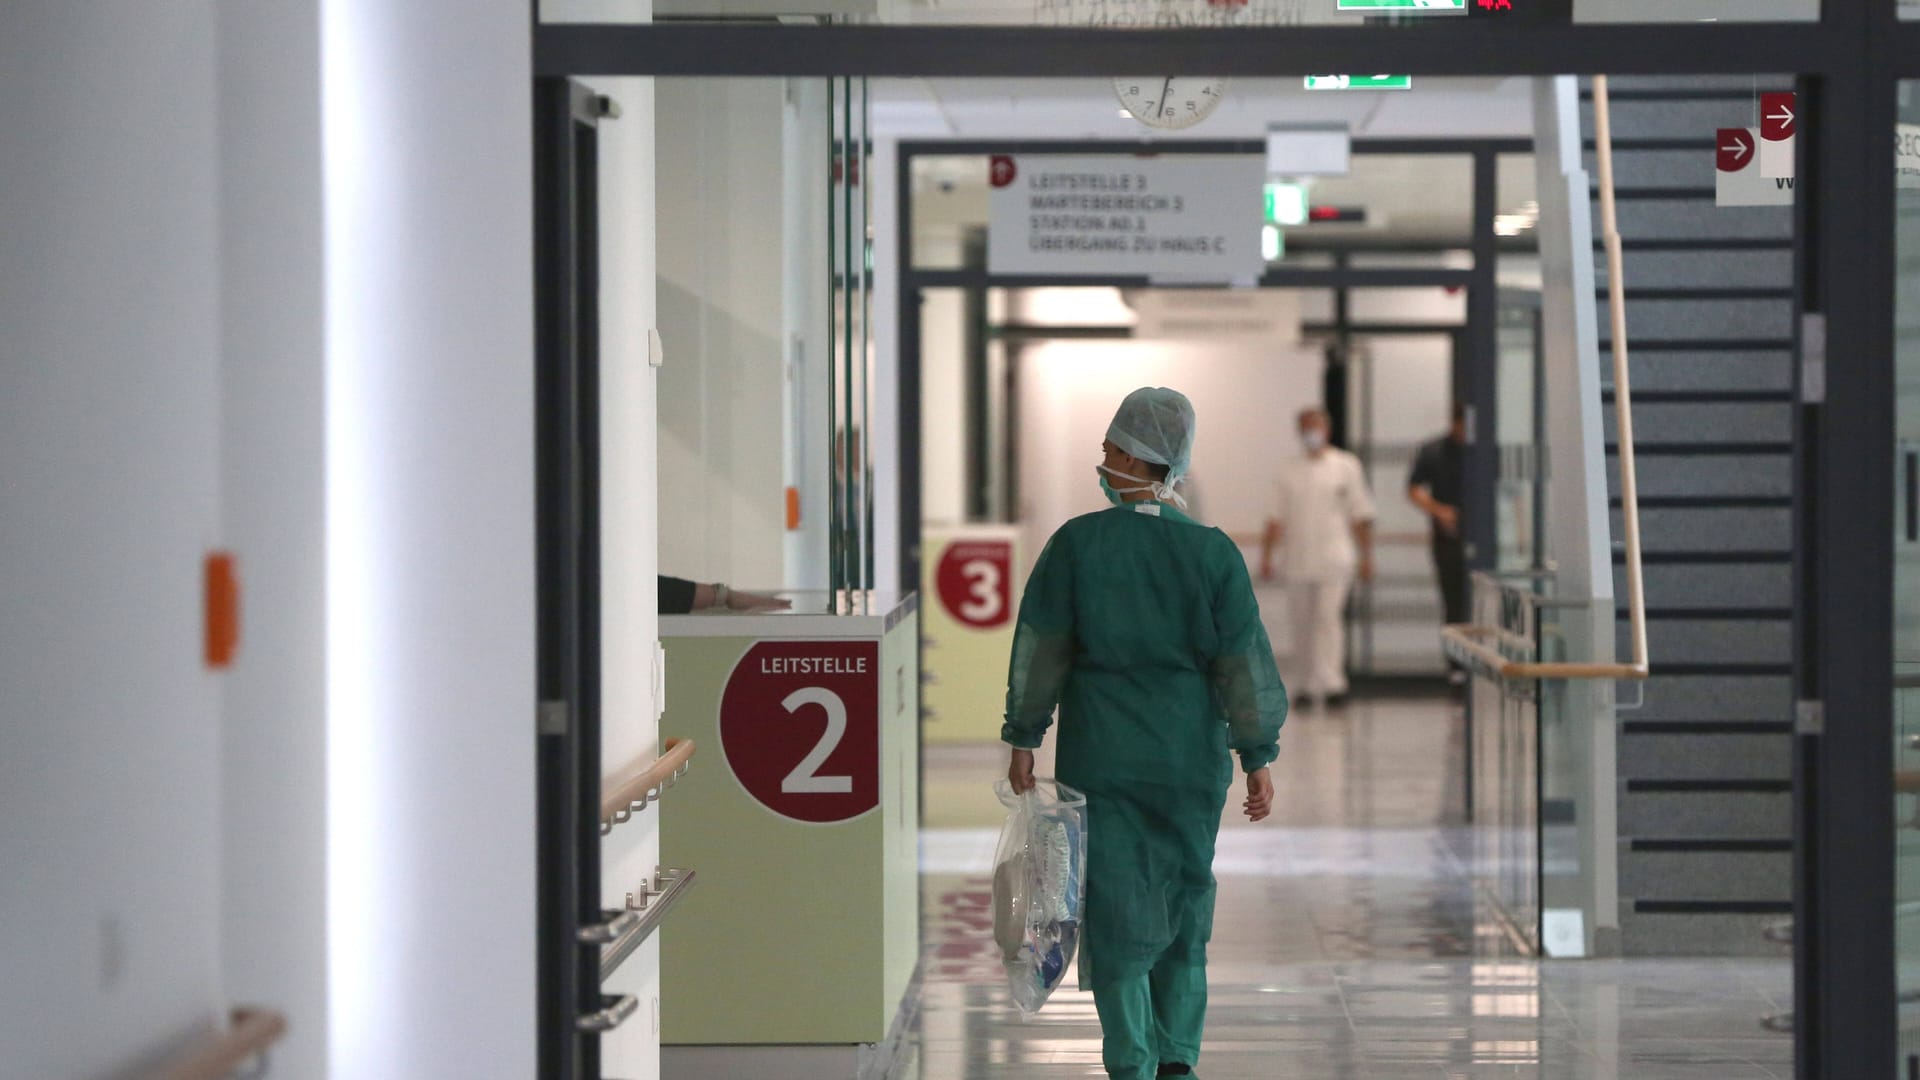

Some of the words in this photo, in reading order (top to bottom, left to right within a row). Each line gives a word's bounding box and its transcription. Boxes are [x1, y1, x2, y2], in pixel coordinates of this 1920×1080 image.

[1129, 86, 1139, 95] 8
[1202, 86, 1211, 95] 4
[1145, 101, 1155, 110] 7
[1165, 107, 1175, 117] 6
[1186, 101, 1196, 110] 5
[1029, 174, 1130, 190] LEITSTELLE
[1029, 215, 1105, 230] STATION
[1029, 234, 1129, 252] ÜBERGANG
[1133, 236, 1156, 252] ZU
[1160, 237, 1210, 253] HAUS
[961, 560, 1001, 620] 3
[761, 657, 867, 674] LEITSTELLE
[780, 686, 853, 793] 2
